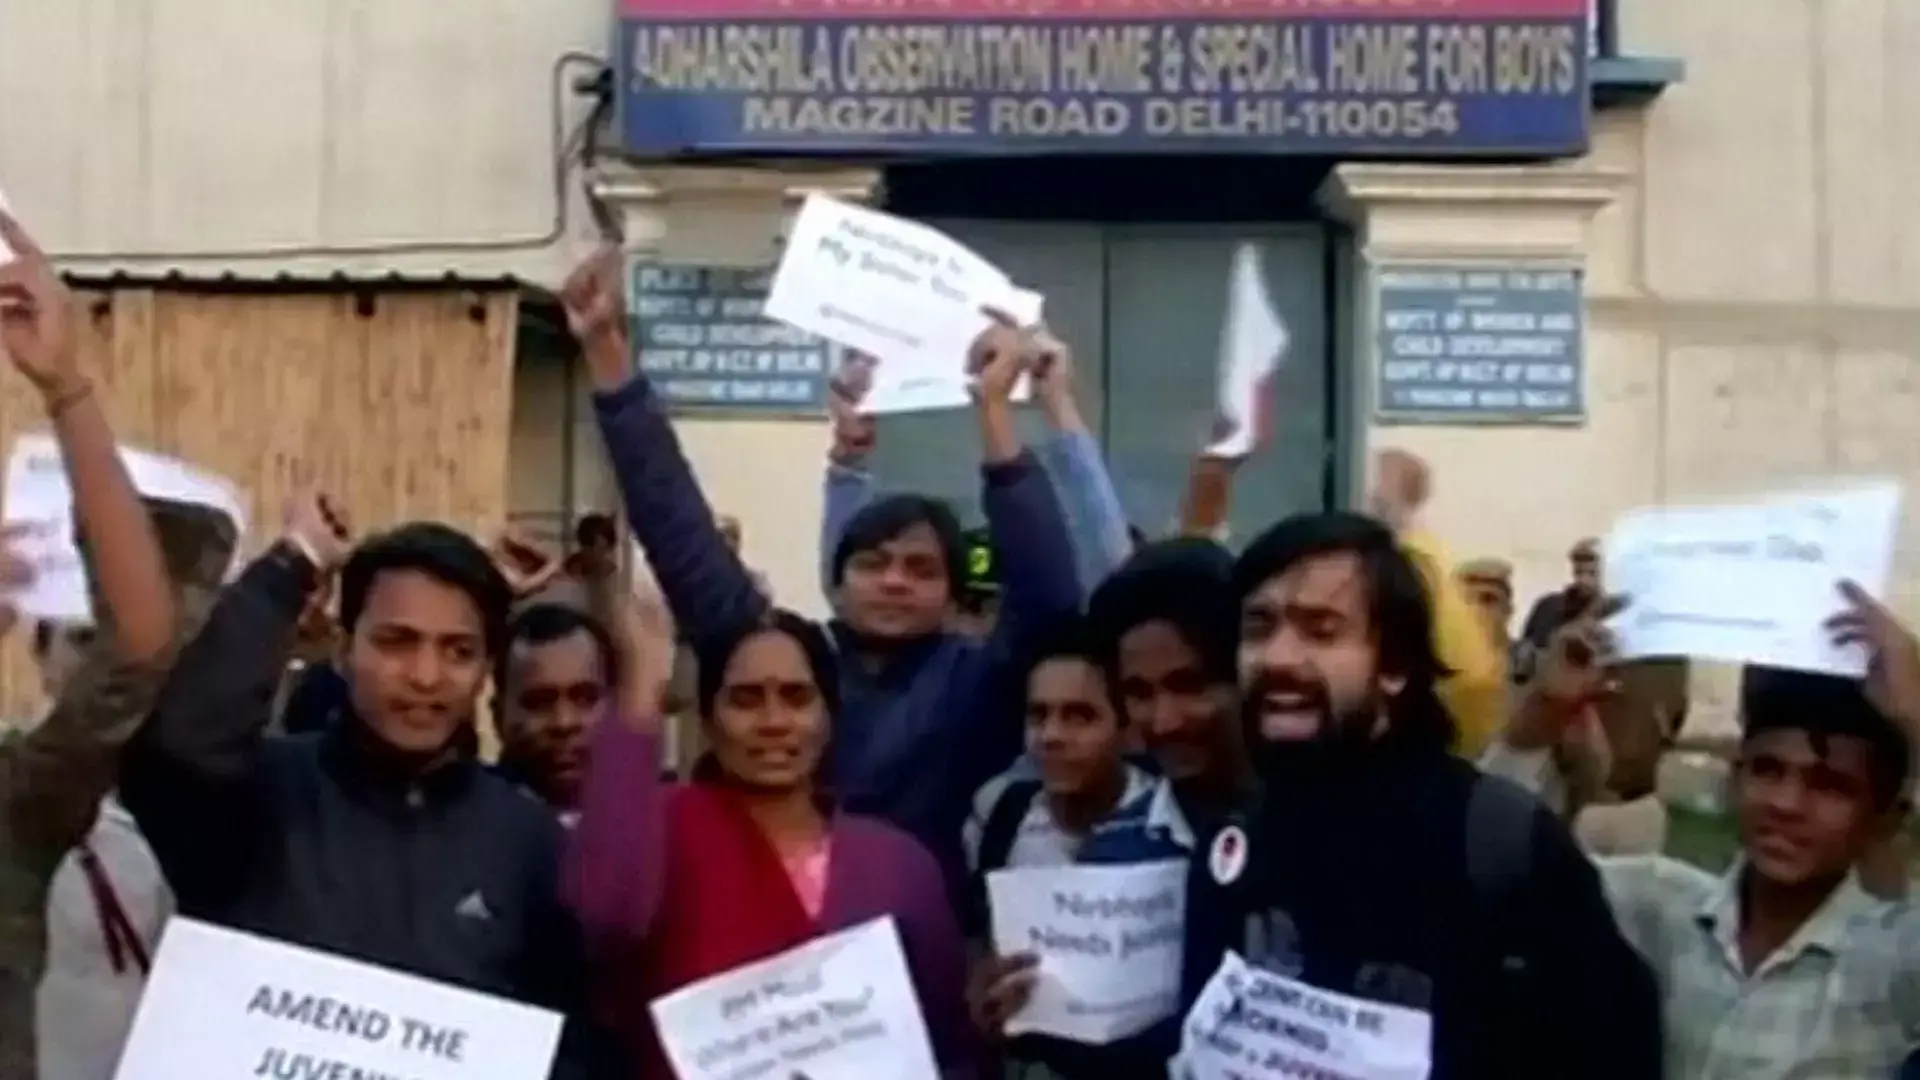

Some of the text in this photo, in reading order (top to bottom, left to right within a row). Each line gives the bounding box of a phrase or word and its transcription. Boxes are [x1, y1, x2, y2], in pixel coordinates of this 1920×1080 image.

[631, 25, 1575, 93] ADHARSHILA OBSERVATION HOME & SPECIAL HOME FOR BOYS
[742, 98, 1460, 137] MAGZINE ROAD DELHI-110054
[246, 983, 470, 1062] AMEND THE
